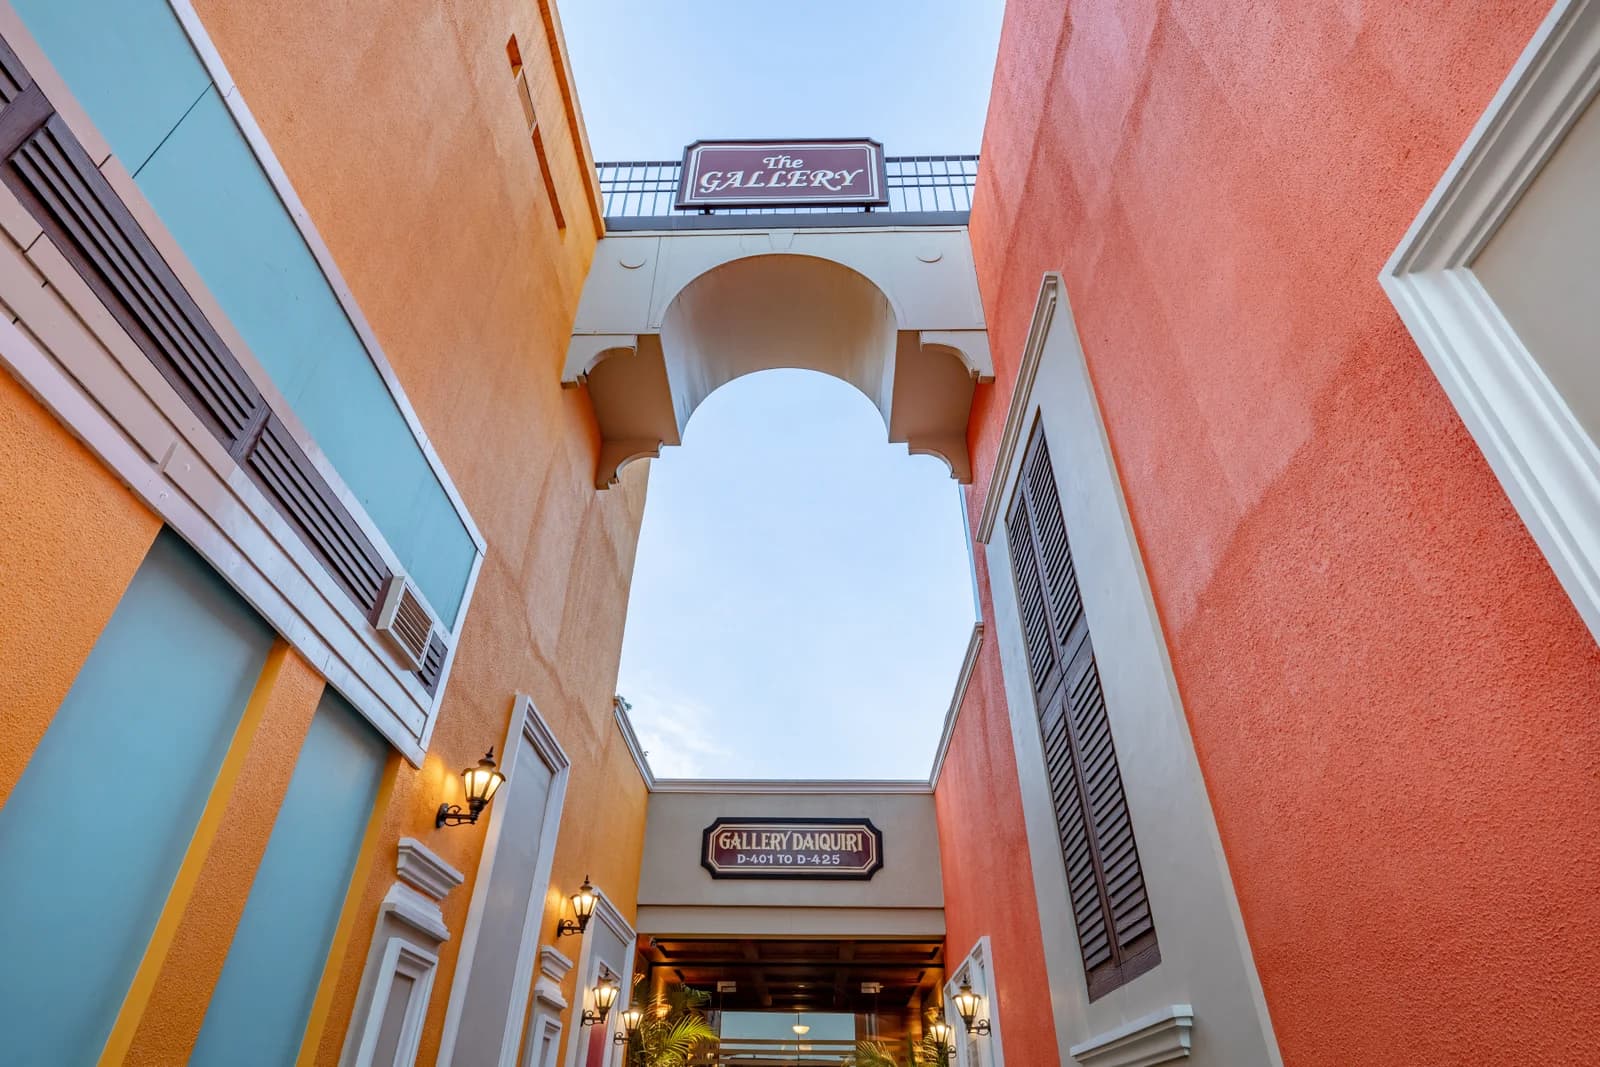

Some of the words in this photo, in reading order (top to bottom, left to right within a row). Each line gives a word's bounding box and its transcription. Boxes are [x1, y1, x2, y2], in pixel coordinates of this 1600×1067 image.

[763, 155, 804, 169] The
[700, 169, 864, 193] GALLERY
[719, 831, 792, 852] GALLERY
[792, 832, 863, 853] DAIQUIRI
[737, 854, 773, 864] D-401
[777, 854, 793, 864] TO
[797, 854, 841, 865] D-425
